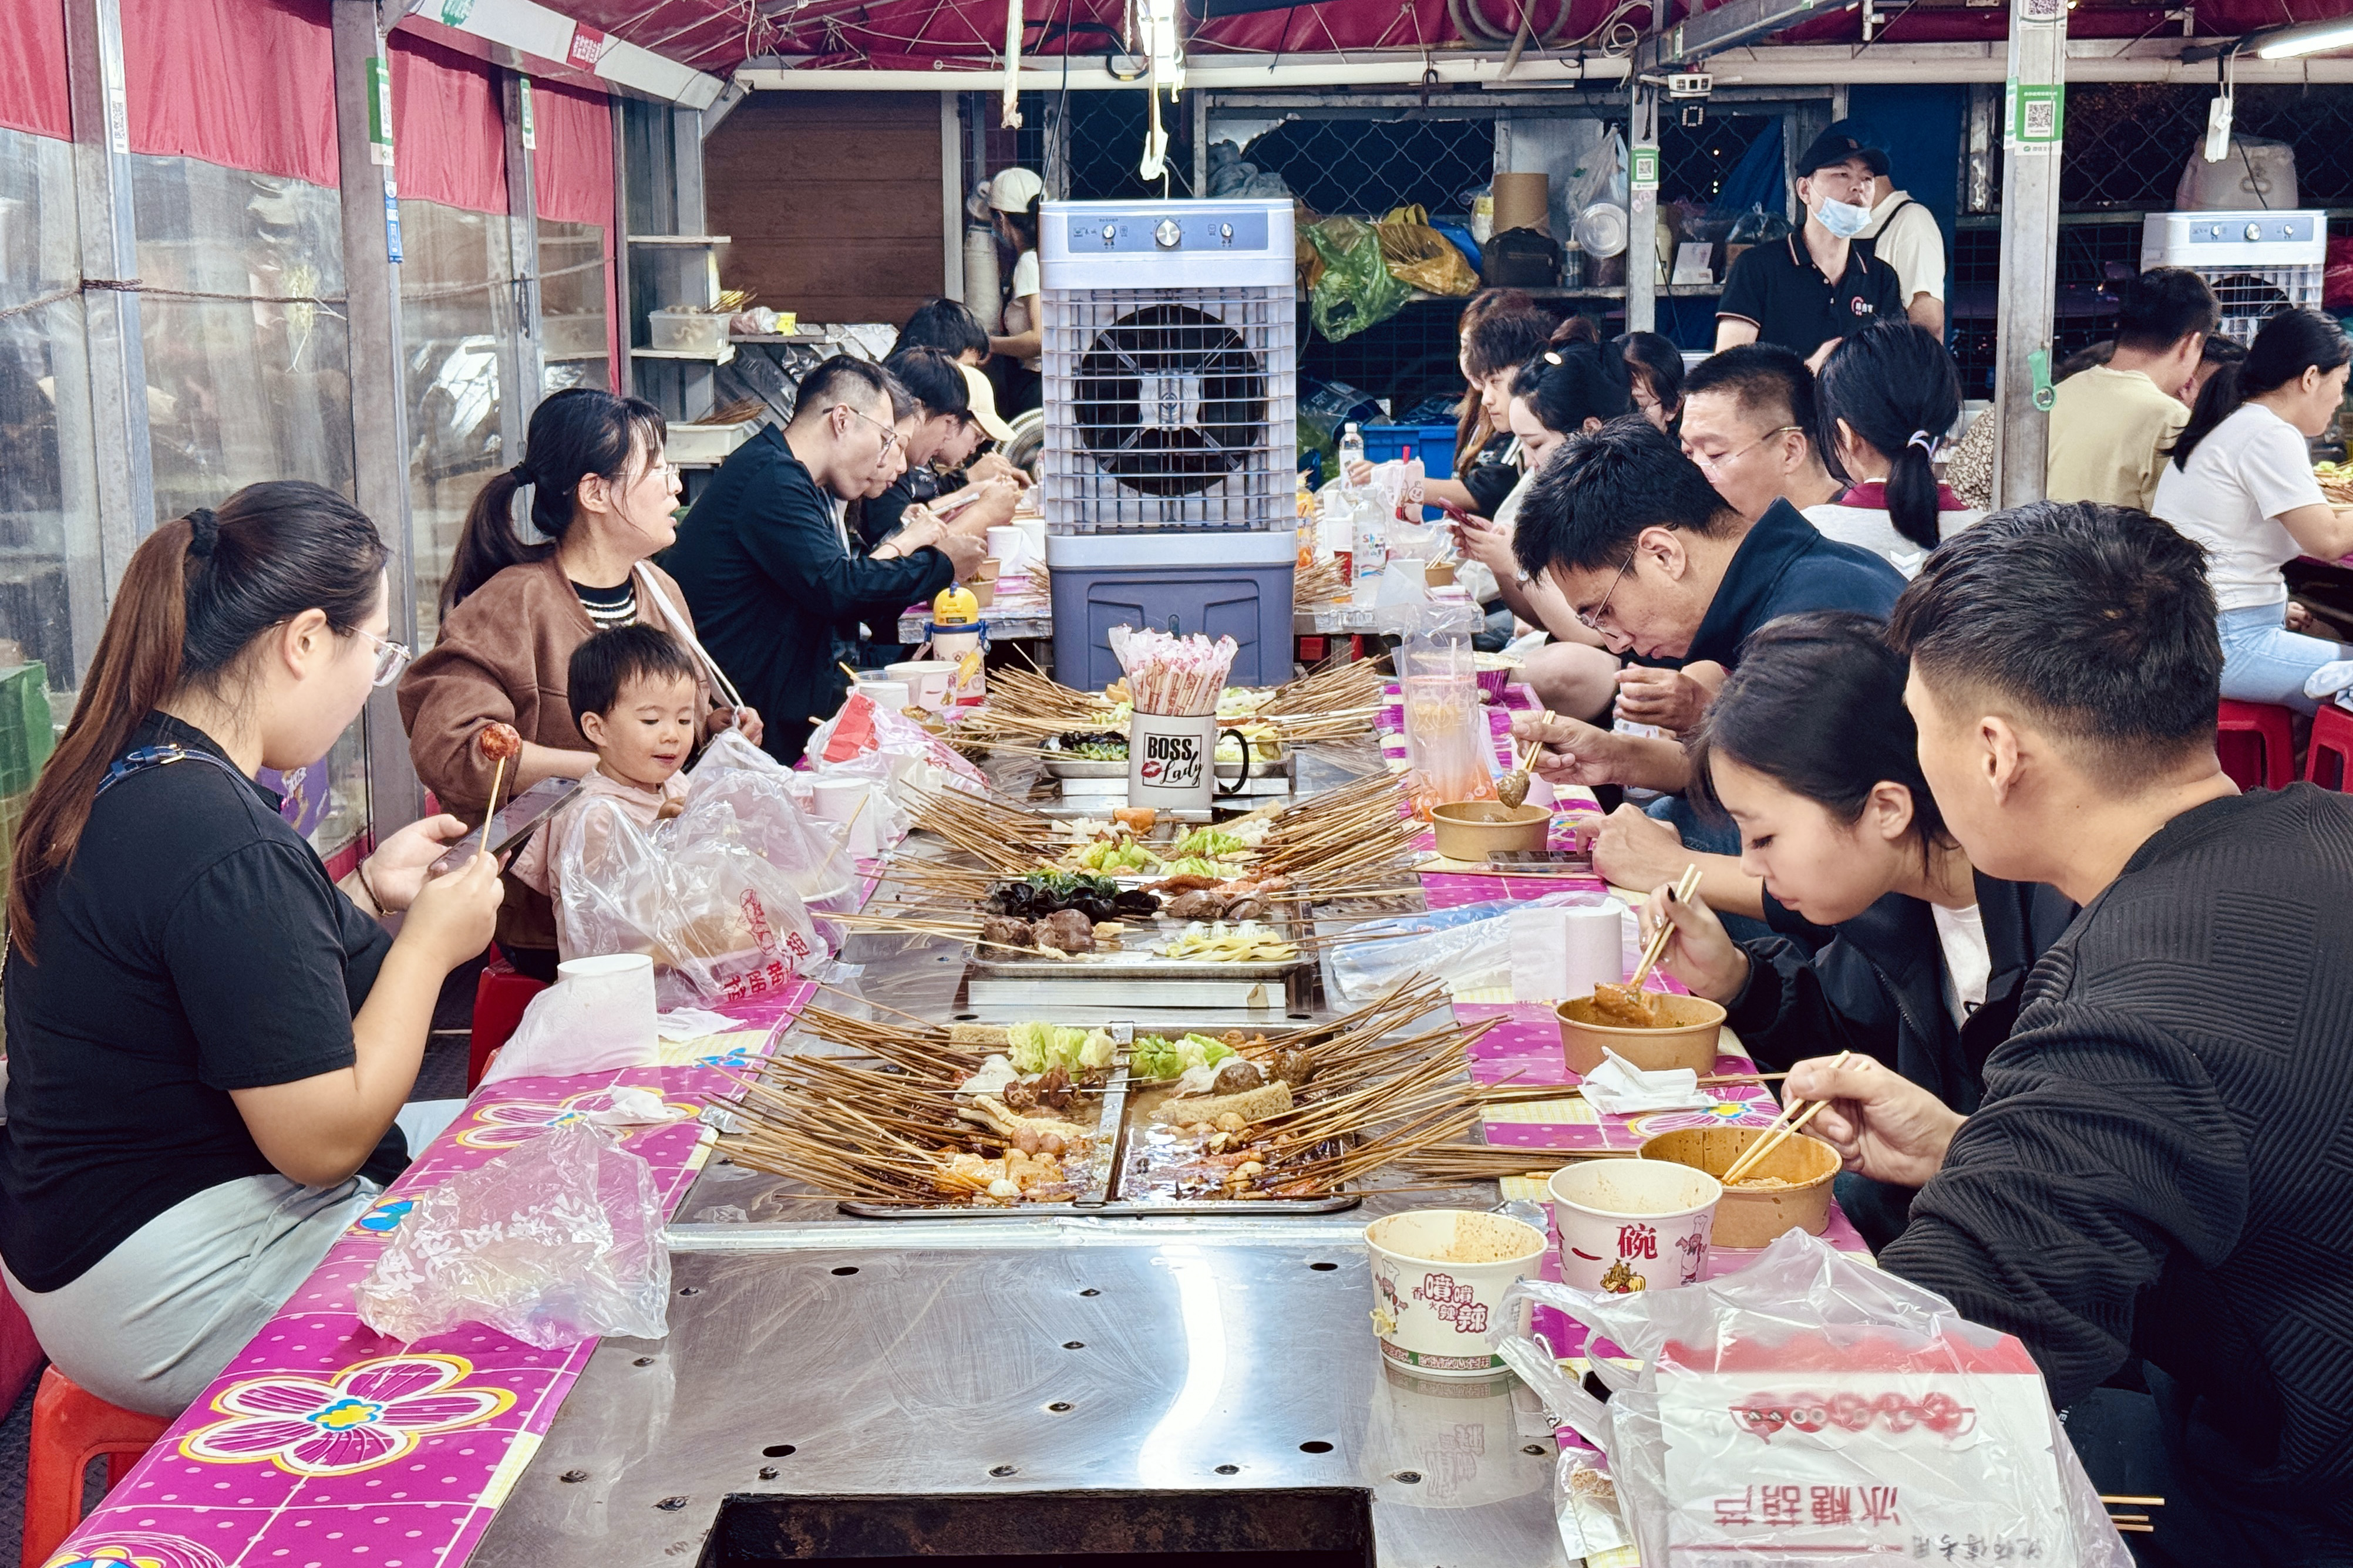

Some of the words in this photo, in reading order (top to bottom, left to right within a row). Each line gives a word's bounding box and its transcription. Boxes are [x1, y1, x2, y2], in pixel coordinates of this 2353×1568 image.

[1147, 736, 1193, 760] BOSS
[1160, 751, 1204, 785] Lady
[1428, 1301, 1489, 1334] 火辣辣
[1714, 1485, 1901, 1527] 冰糖葫芦
